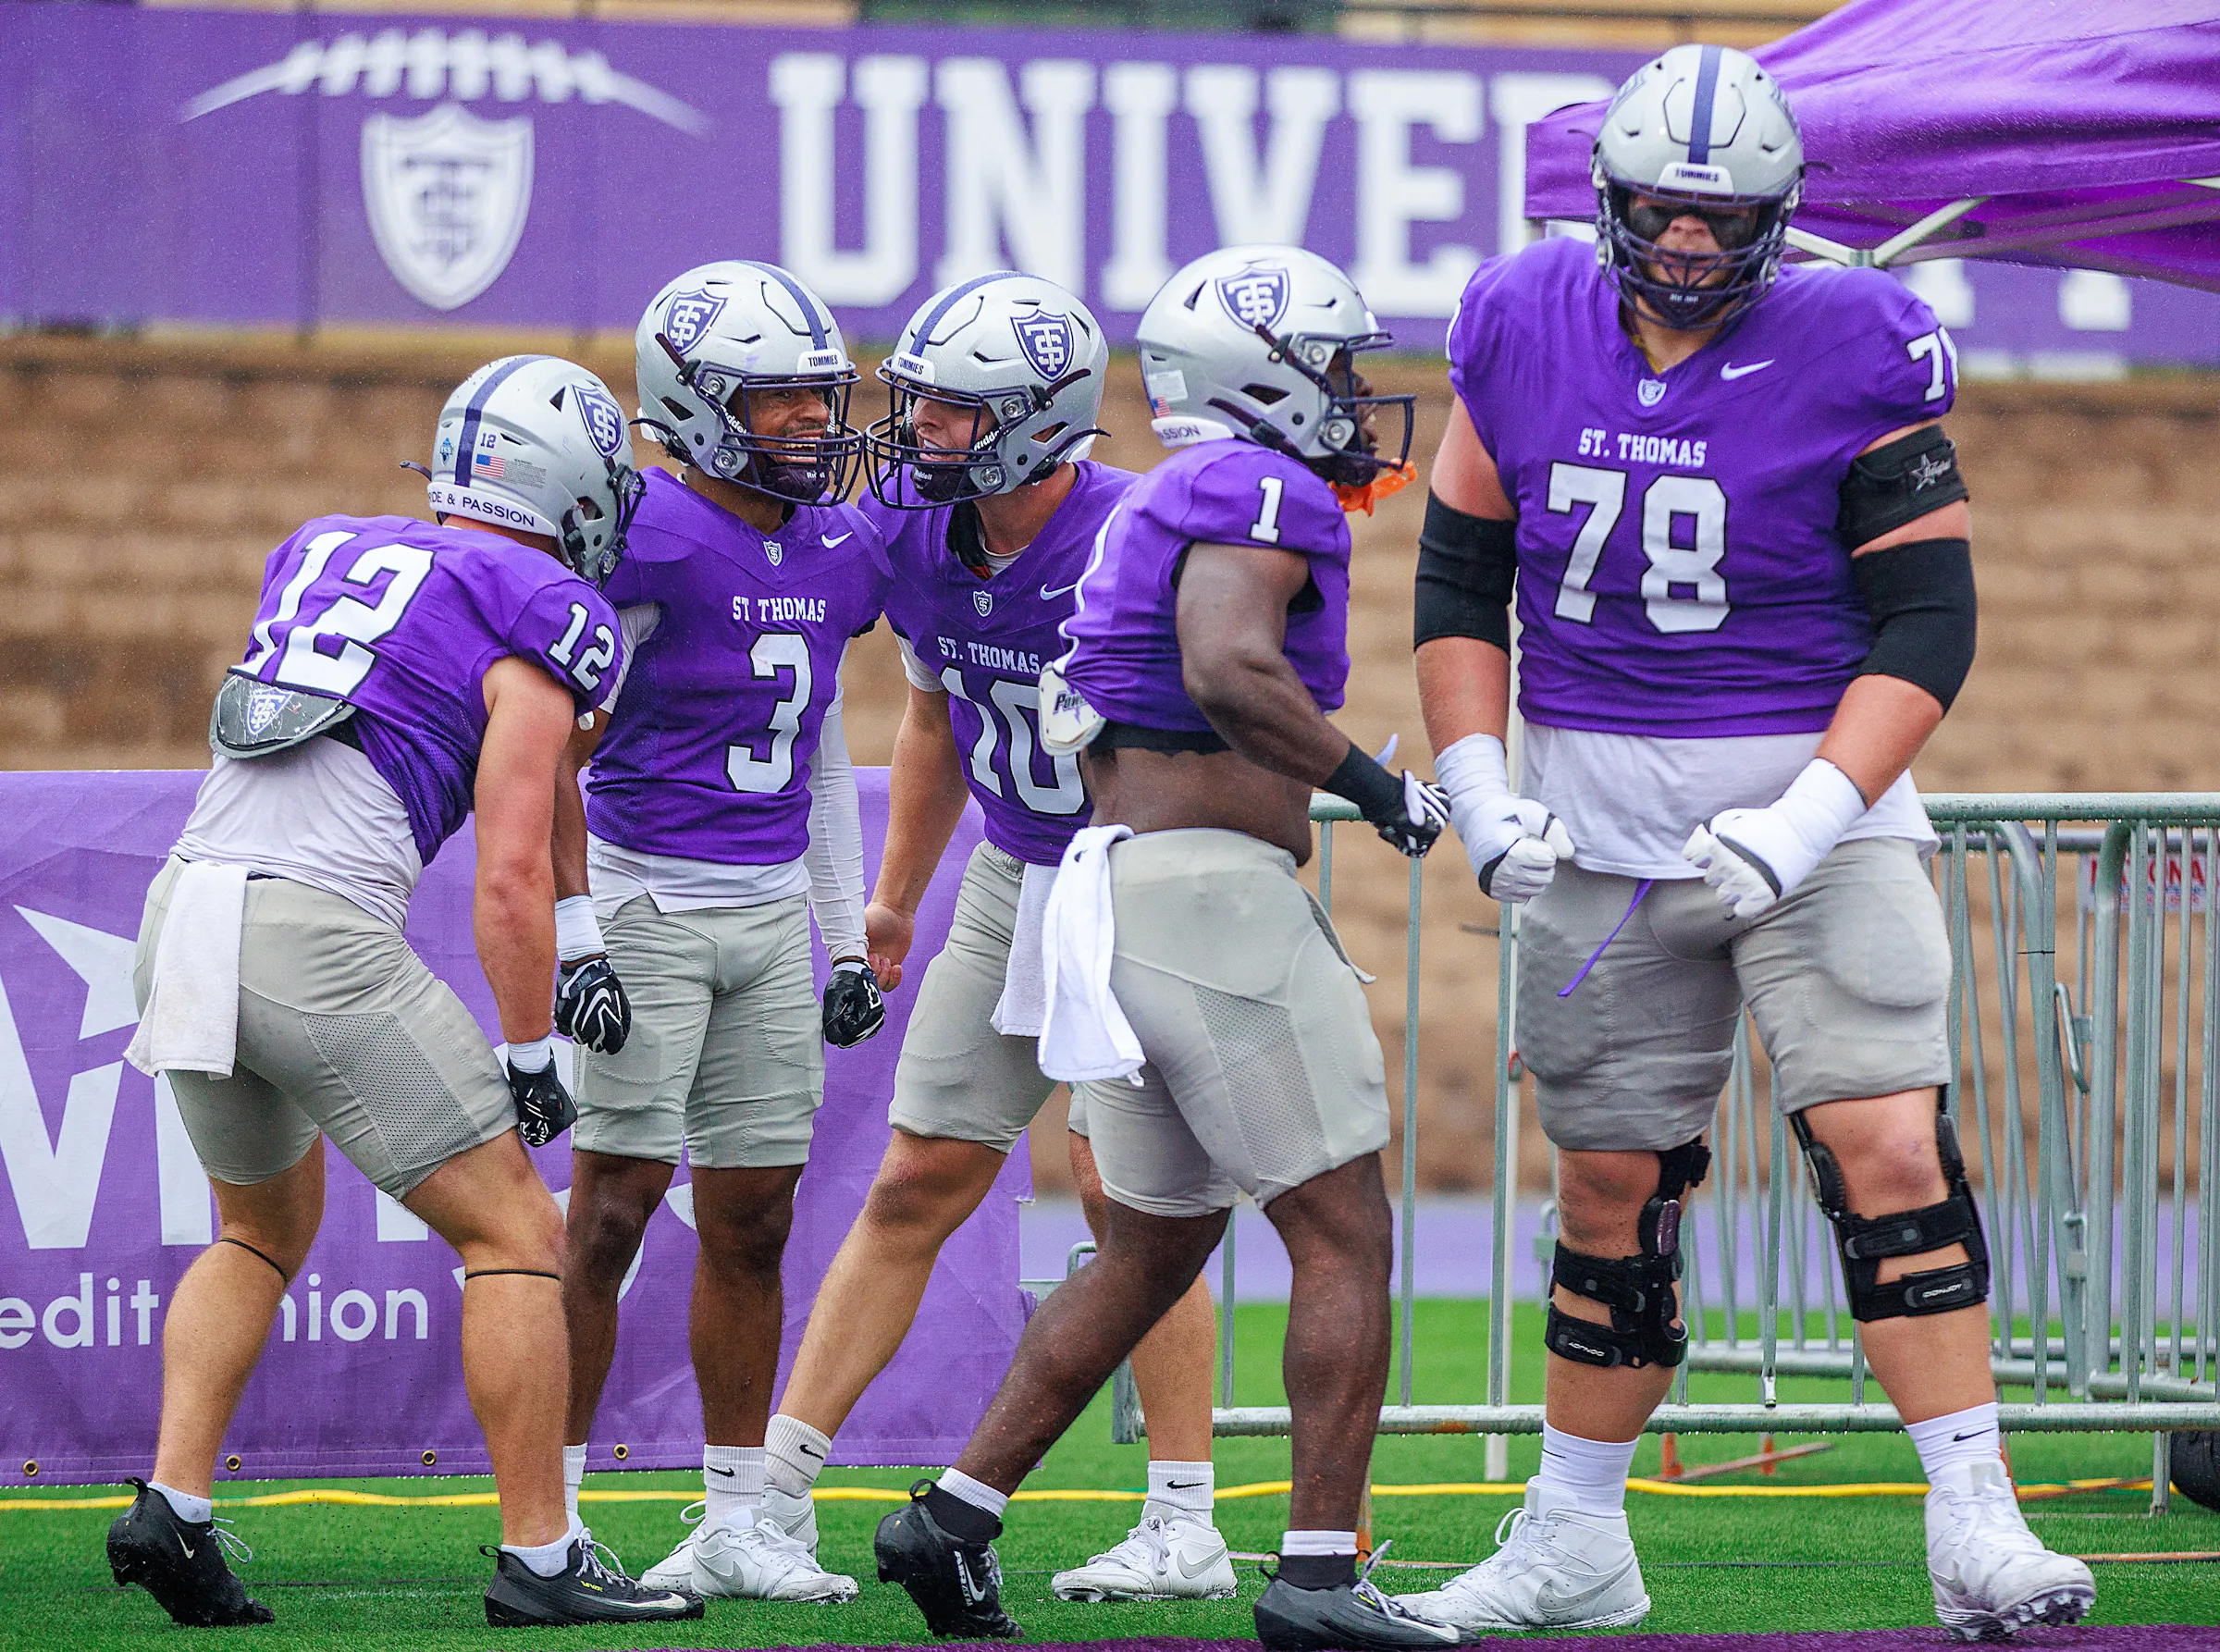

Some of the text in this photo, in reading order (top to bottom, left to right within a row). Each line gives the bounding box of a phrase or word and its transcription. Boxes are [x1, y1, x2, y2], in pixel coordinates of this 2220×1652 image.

[808, 354, 839, 367] TOMMIES
[897, 356, 924, 375] TOMMIES
[1906, 326, 1959, 402] 7
[480, 433, 497, 449] 12
[1578, 427, 1708, 468] ST. THOMAS
[447, 493, 455, 505] &
[462, 496, 535, 527] PASSION
[1250, 475, 1283, 544] 1
[1548, 462, 1731, 634] 78
[228, 530, 435, 698] 12
[758, 598, 826, 623] THOMAS
[547, 601, 617, 692] 12
[937, 635, 1041, 675] ST. THOMAS
[724, 631, 812, 794] 3
[940, 665, 1086, 815] 10
[279, 1273, 428, 1342] ion
[954, 1551, 967, 1585] AIR
